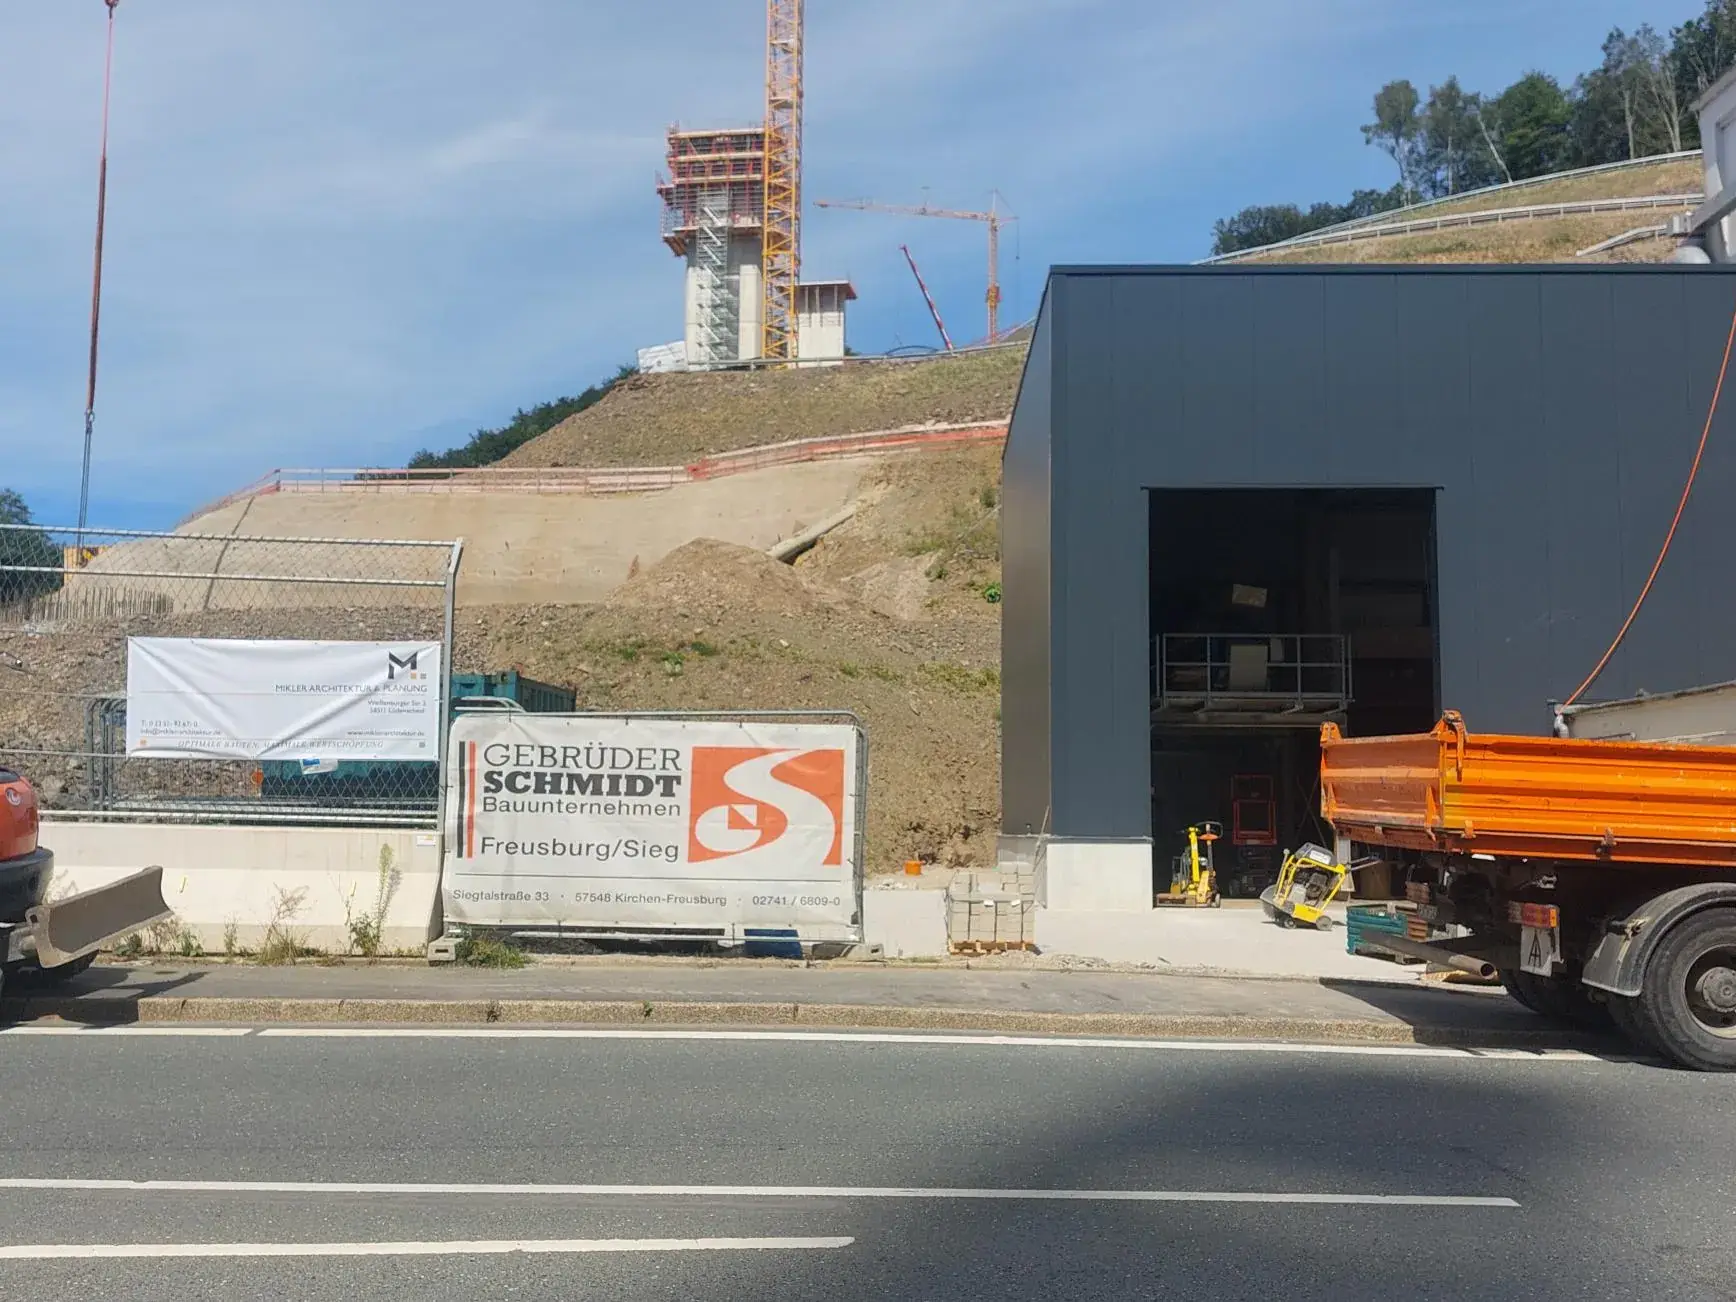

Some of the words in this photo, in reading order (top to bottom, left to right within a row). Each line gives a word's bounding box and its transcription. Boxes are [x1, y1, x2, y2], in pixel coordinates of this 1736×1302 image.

[275, 684, 309, 693] MIKLER
[309, 684, 371, 693] ARCHITEKTUR
[383, 684, 428, 693] PLANUNG
[483, 742, 682, 771] GEBRÜDER
[483, 770, 682, 798] SCHMIDT
[482, 796, 681, 816] Bauunternehmen
[481, 836, 679, 862] Freusburg/Sieg
[452, 889, 531, 902] Siegtalstraße
[535, 891, 549, 900] 33
[575, 892, 611, 902] 57548
[615, 893, 727, 907] Kirchen-Freusburg
[752, 895, 787, 906] 02741
[800, 896, 841, 906] 6809-0
